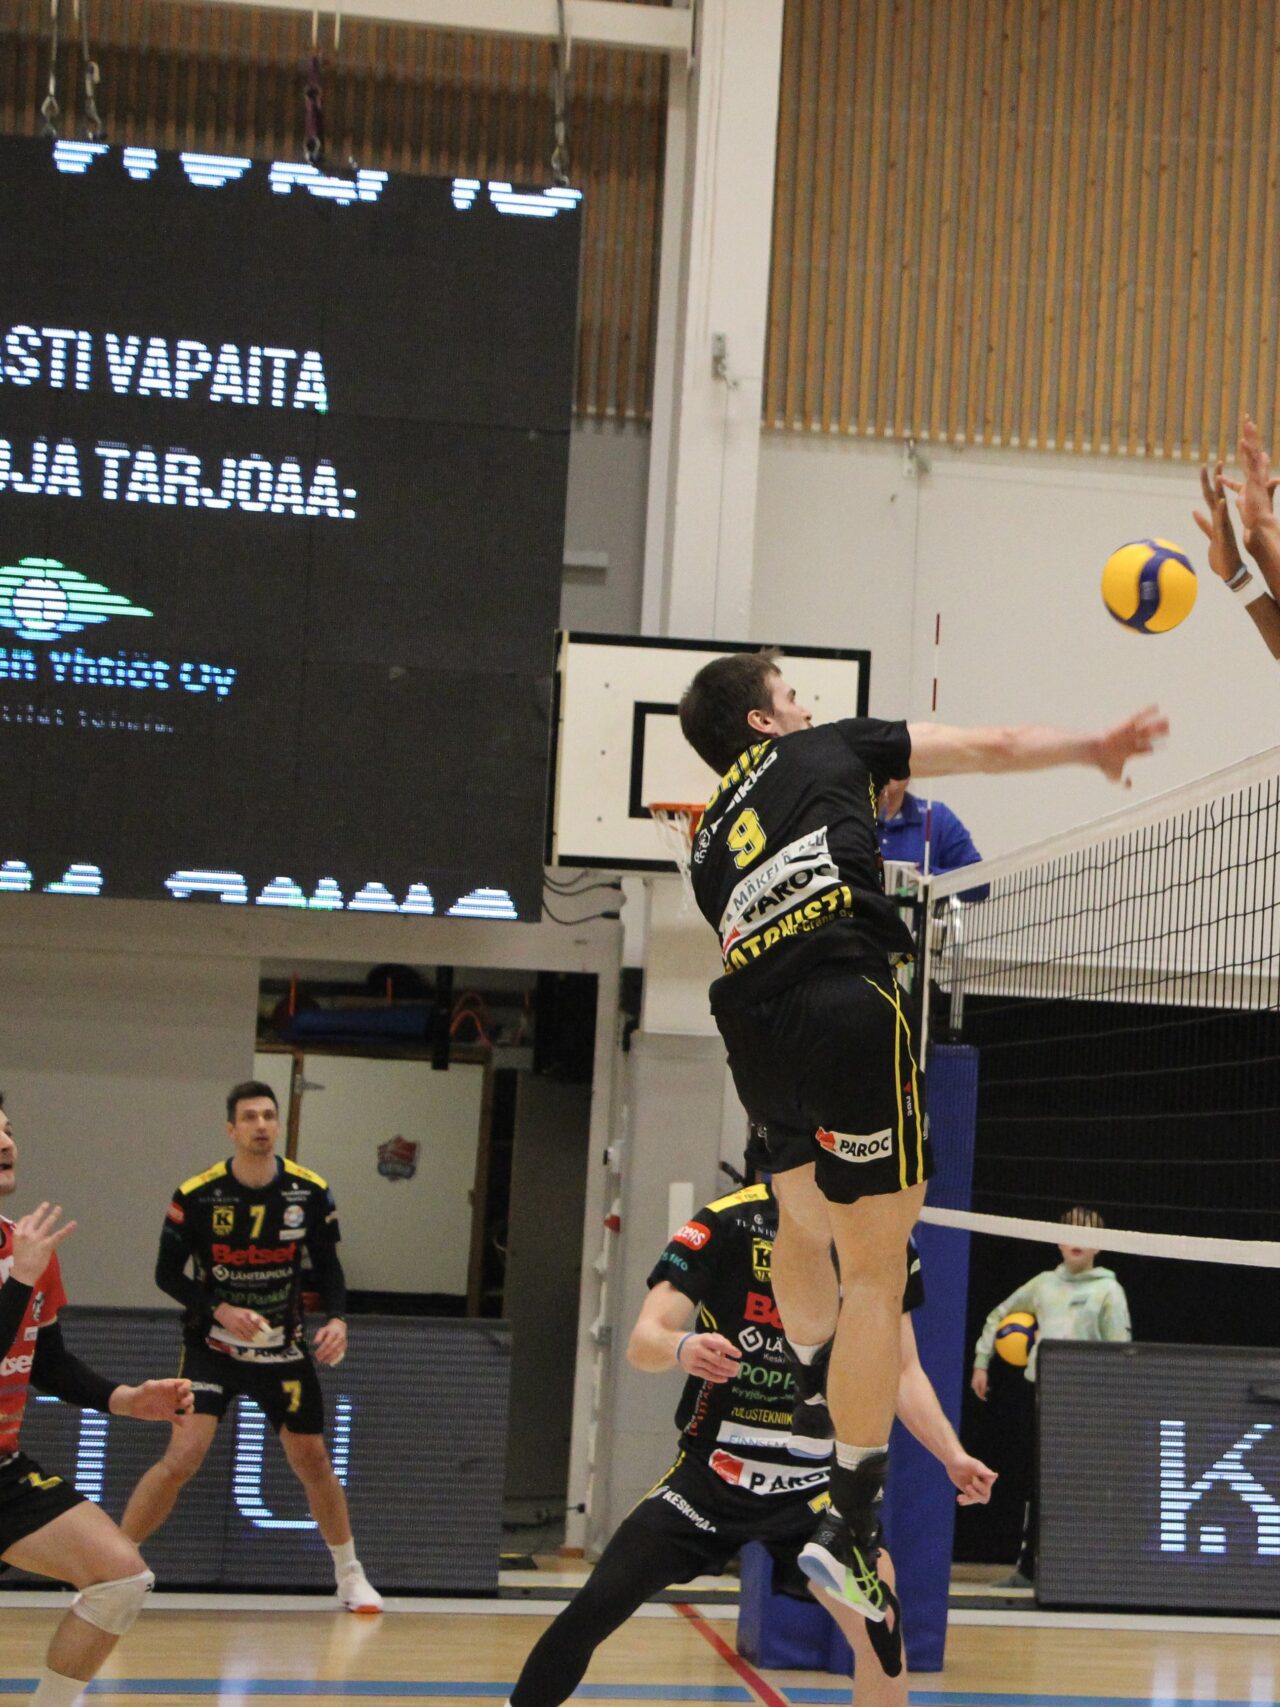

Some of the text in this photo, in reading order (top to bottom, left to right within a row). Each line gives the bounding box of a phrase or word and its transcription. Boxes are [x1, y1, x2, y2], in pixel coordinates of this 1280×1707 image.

[0, 324, 329, 412] STI VAPAITA
[726, 807, 768, 869] 9
[839, 1136, 890, 1158] PAROC
[249, 1204, 266, 1239] 7
[281, 1380, 301, 1412] 7
